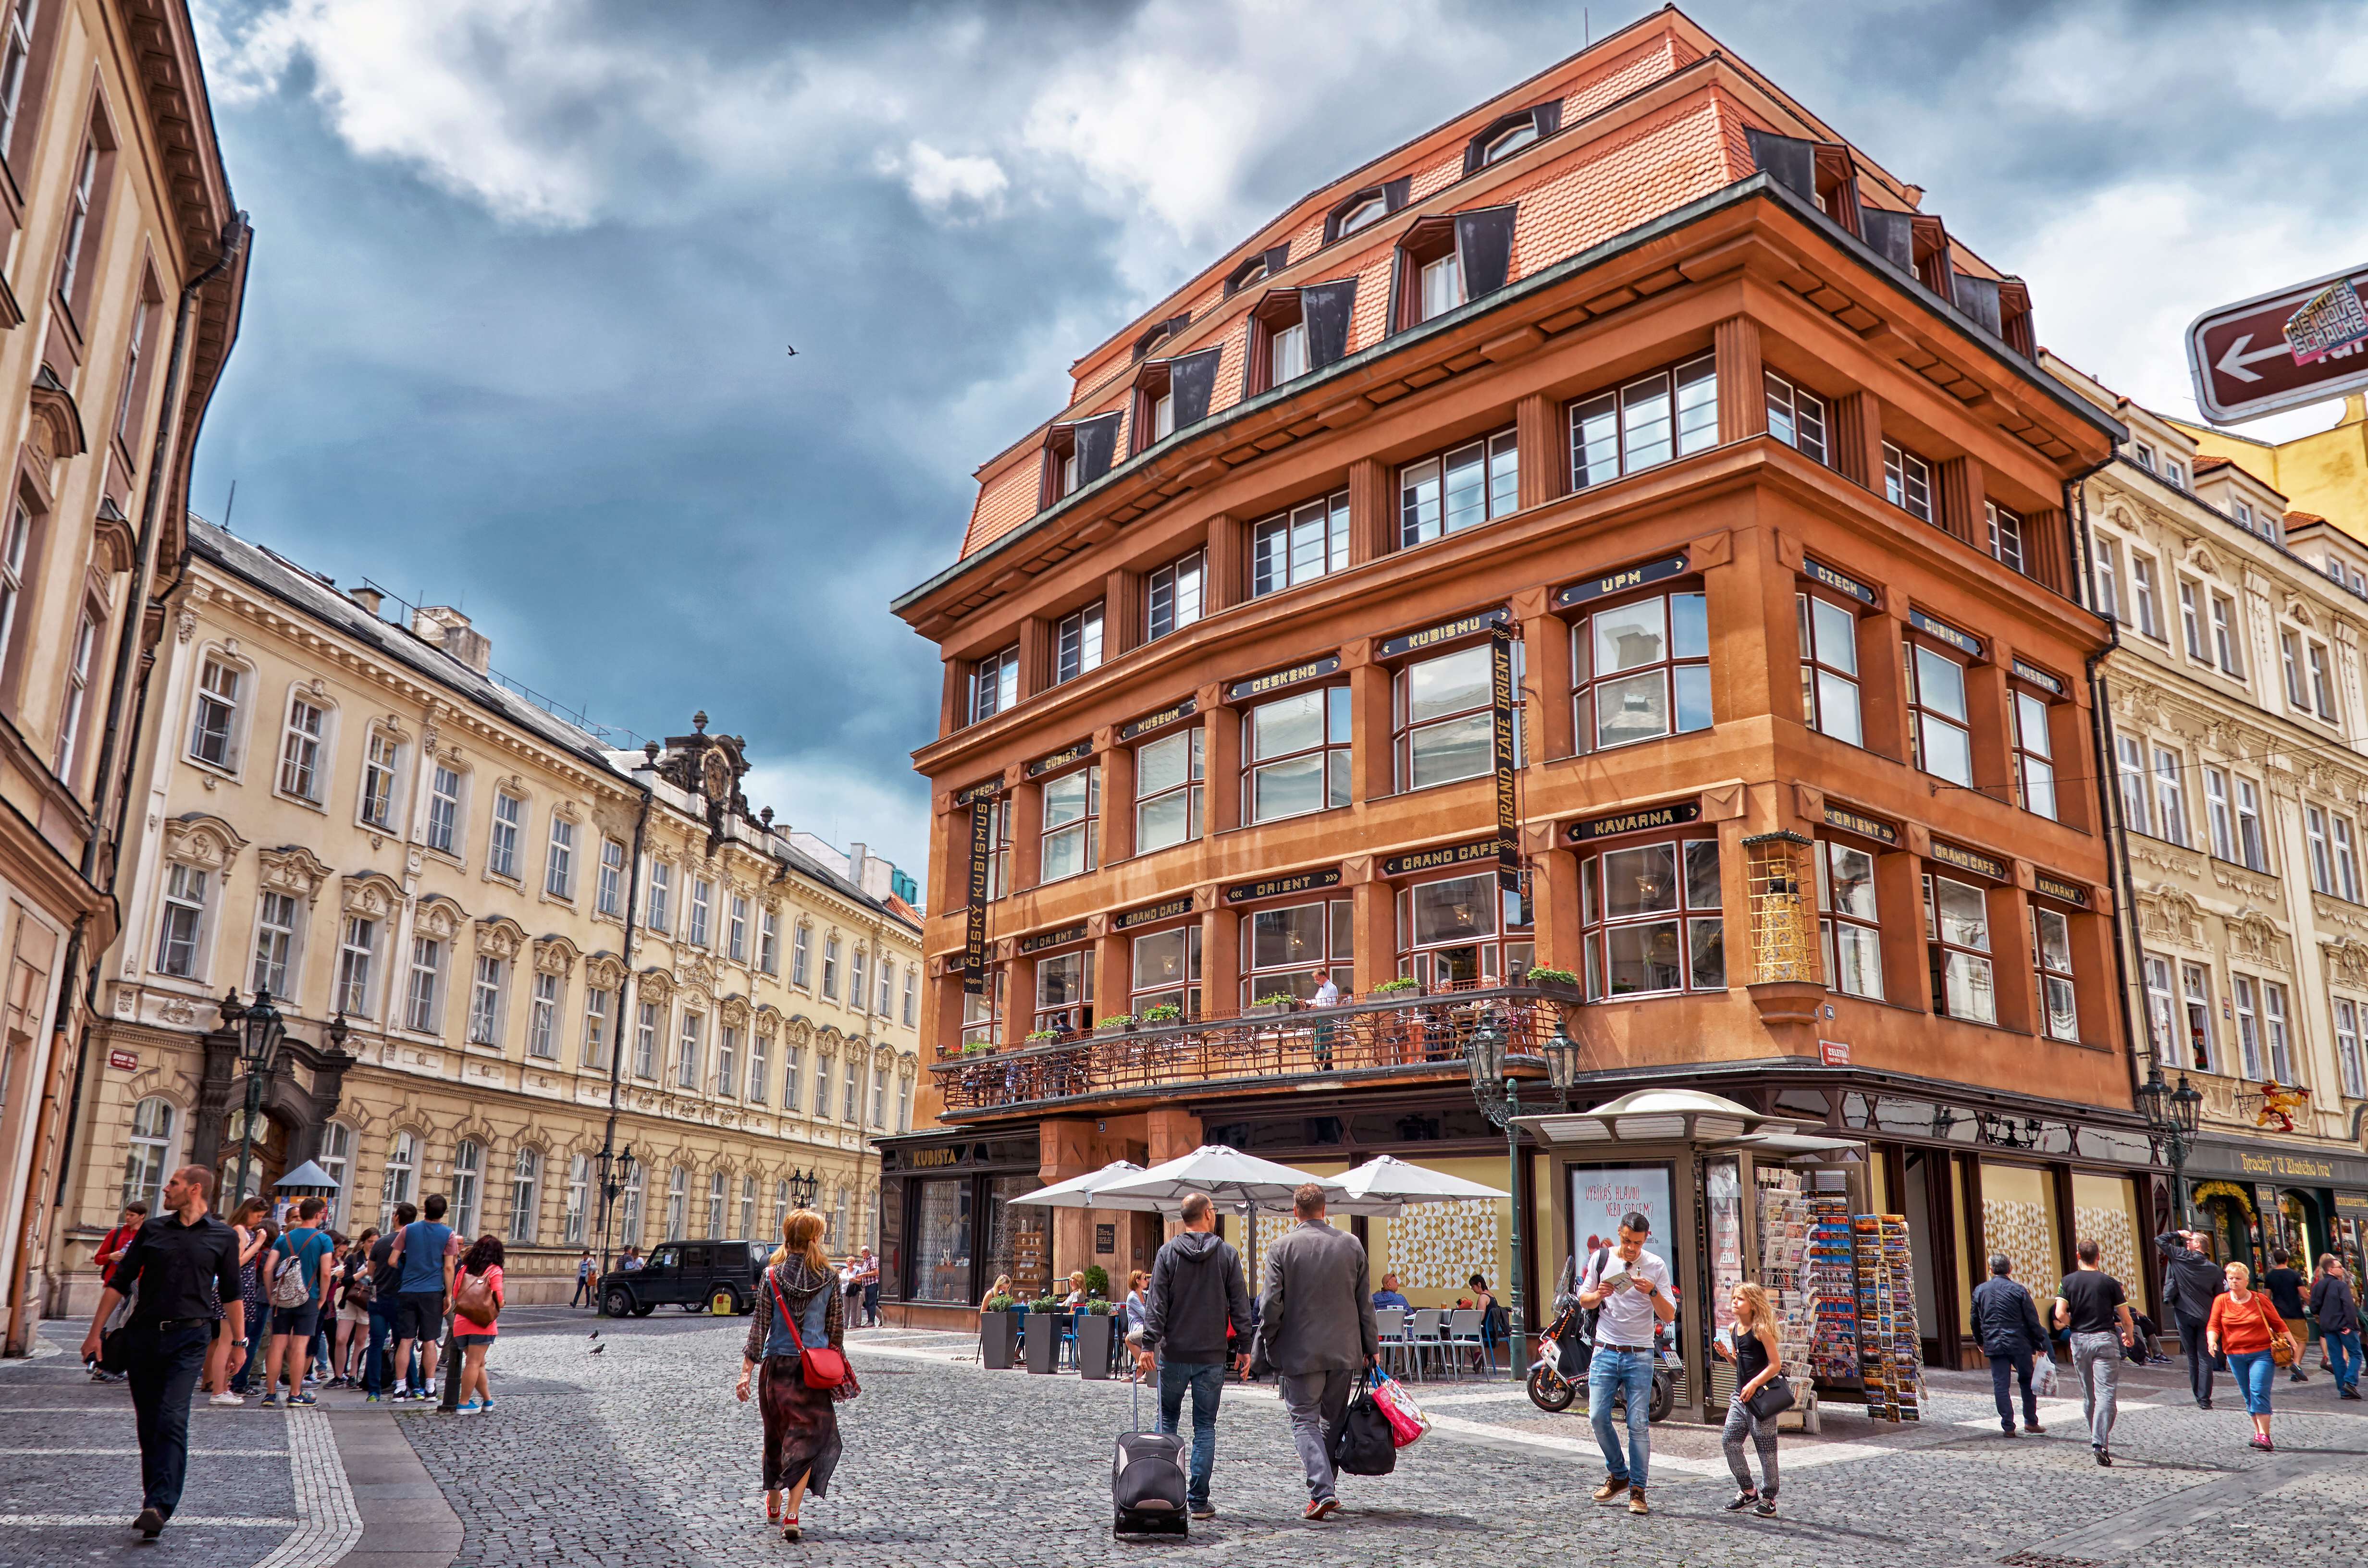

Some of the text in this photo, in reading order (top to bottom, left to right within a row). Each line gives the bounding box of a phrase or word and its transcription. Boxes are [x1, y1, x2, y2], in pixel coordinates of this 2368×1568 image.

[2289, 317, 2315, 339] WE
[2316, 296, 2361, 330] LOVE
[2293, 313, 2368, 356] SCHALKE
[1601, 570, 1641, 592] UPM
[1817, 566, 1858, 596] CZECH
[1408, 616, 1480, 648] KUBISMU
[1924, 618, 1963, 647] CUBISM
[2017, 662, 2055, 689] MUSEUM
[1137, 708, 1179, 733] MUSEUM
[1495, 649, 1514, 829] GRAND CAFE ORIENT
[1046, 749, 1077, 769] CUBISM
[1834, 811, 1879, 837] ORIENT
[973, 803, 987, 898] KUBISMUS
[1403, 841, 1500, 870] GRAND CAFE
[1935, 844, 1968, 867] GRAND
[1257, 876, 1310, 896] ORIENT
[1126, 909, 1157, 926] GRAND
[965, 905, 983, 968] ČESKÝ
[1039, 930, 1073, 947] ORIENT
[913, 1148, 957, 1166] KUBISTA
[1585, 1183, 1640, 1201] VYBÍRÁŠ HLAVOU
[1606, 1202, 1621, 1217] NEBO
[1719, 1237, 1733, 1249] hraje
[1720, 1250, 1735, 1264] JEŽKA
